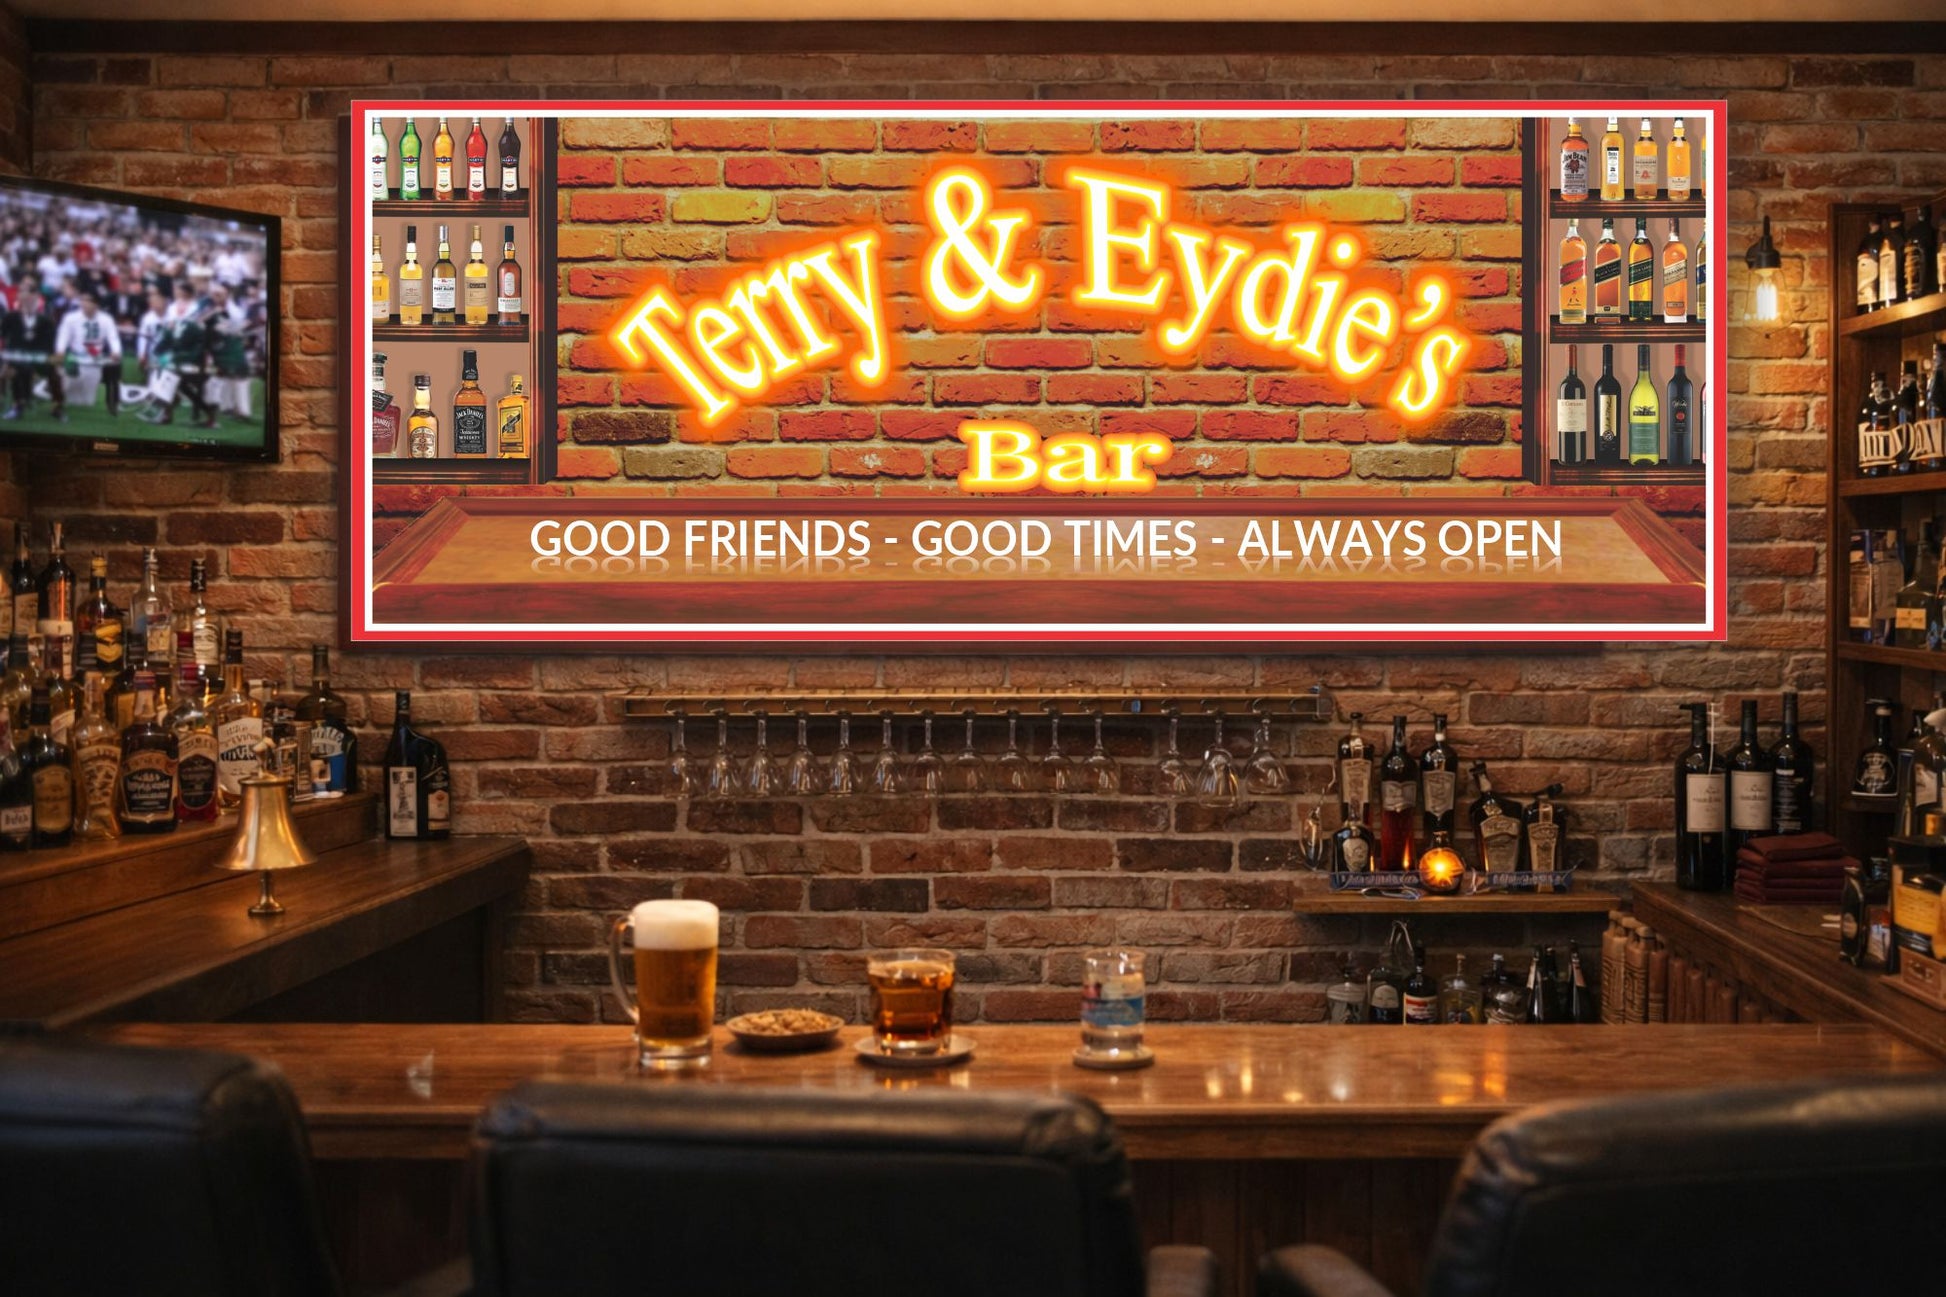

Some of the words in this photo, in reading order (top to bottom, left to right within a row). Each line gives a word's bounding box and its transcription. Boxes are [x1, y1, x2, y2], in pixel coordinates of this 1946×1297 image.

[615, 235, 876, 424] Terry
[926, 170, 1039, 315] &
[1068, 171, 1466, 415] Eydie's
[961, 426, 1165, 486] Bar
[530, 519, 671, 557] GOOD
[684, 519, 872, 557] FRIENDS
[911, 519, 1053, 557] GOOD
[1063, 519, 1198, 557] TIMES
[1236, 519, 1427, 557] ALWAYS
[1437, 519, 1562, 557] OPEN
